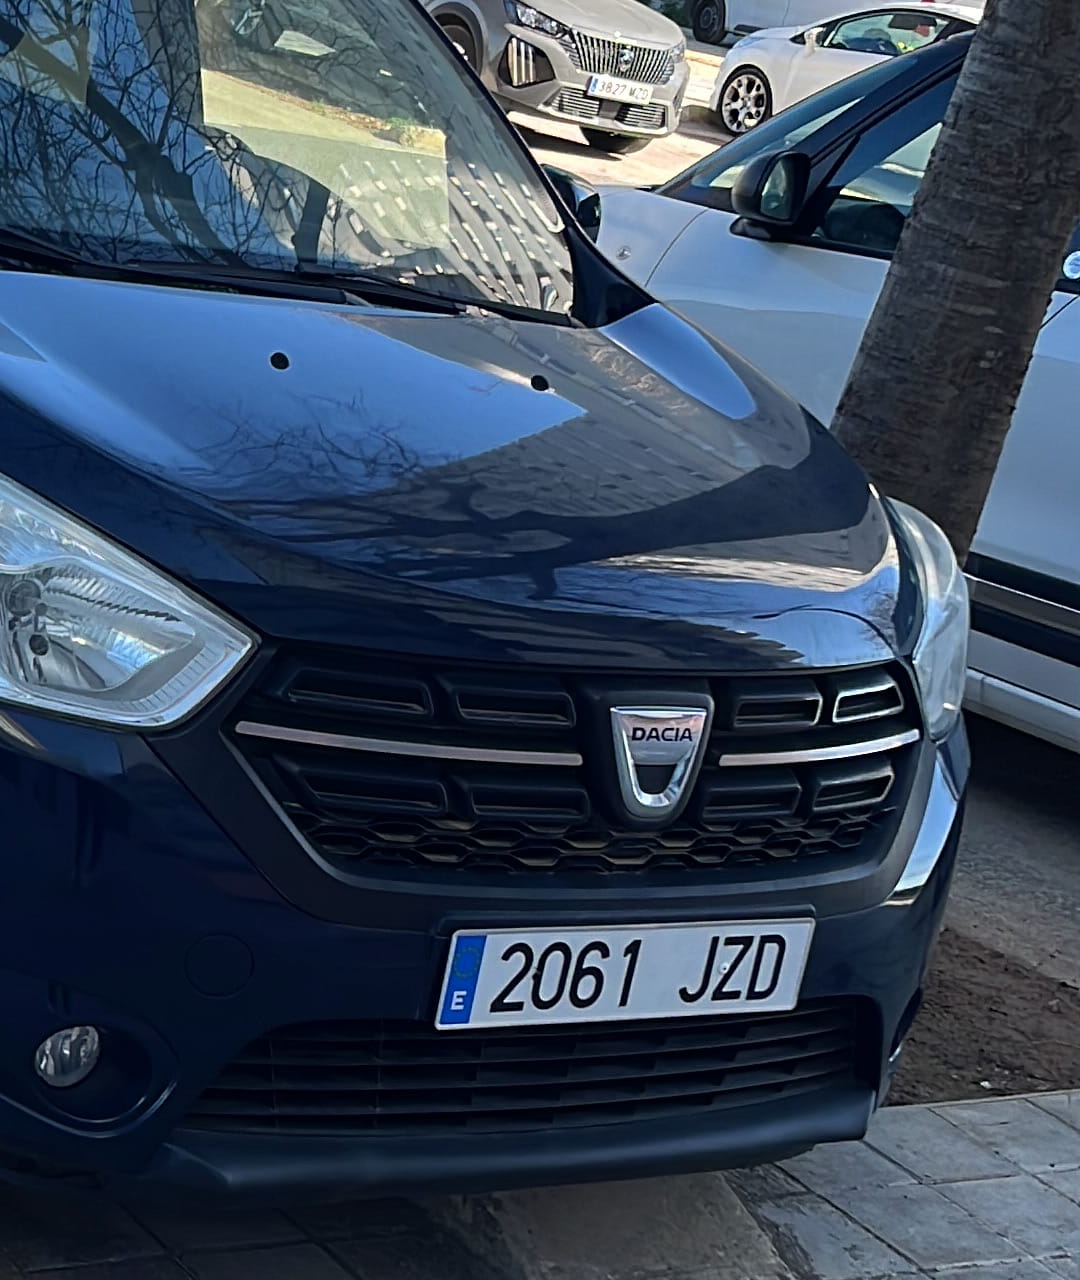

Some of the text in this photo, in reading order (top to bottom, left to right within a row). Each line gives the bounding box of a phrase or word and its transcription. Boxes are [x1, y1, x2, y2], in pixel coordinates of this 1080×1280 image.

[598, 81, 627, 96] 3827
[631, 727, 693, 742] DACIA
[450, 933, 787, 1013] E 2061 JZD
